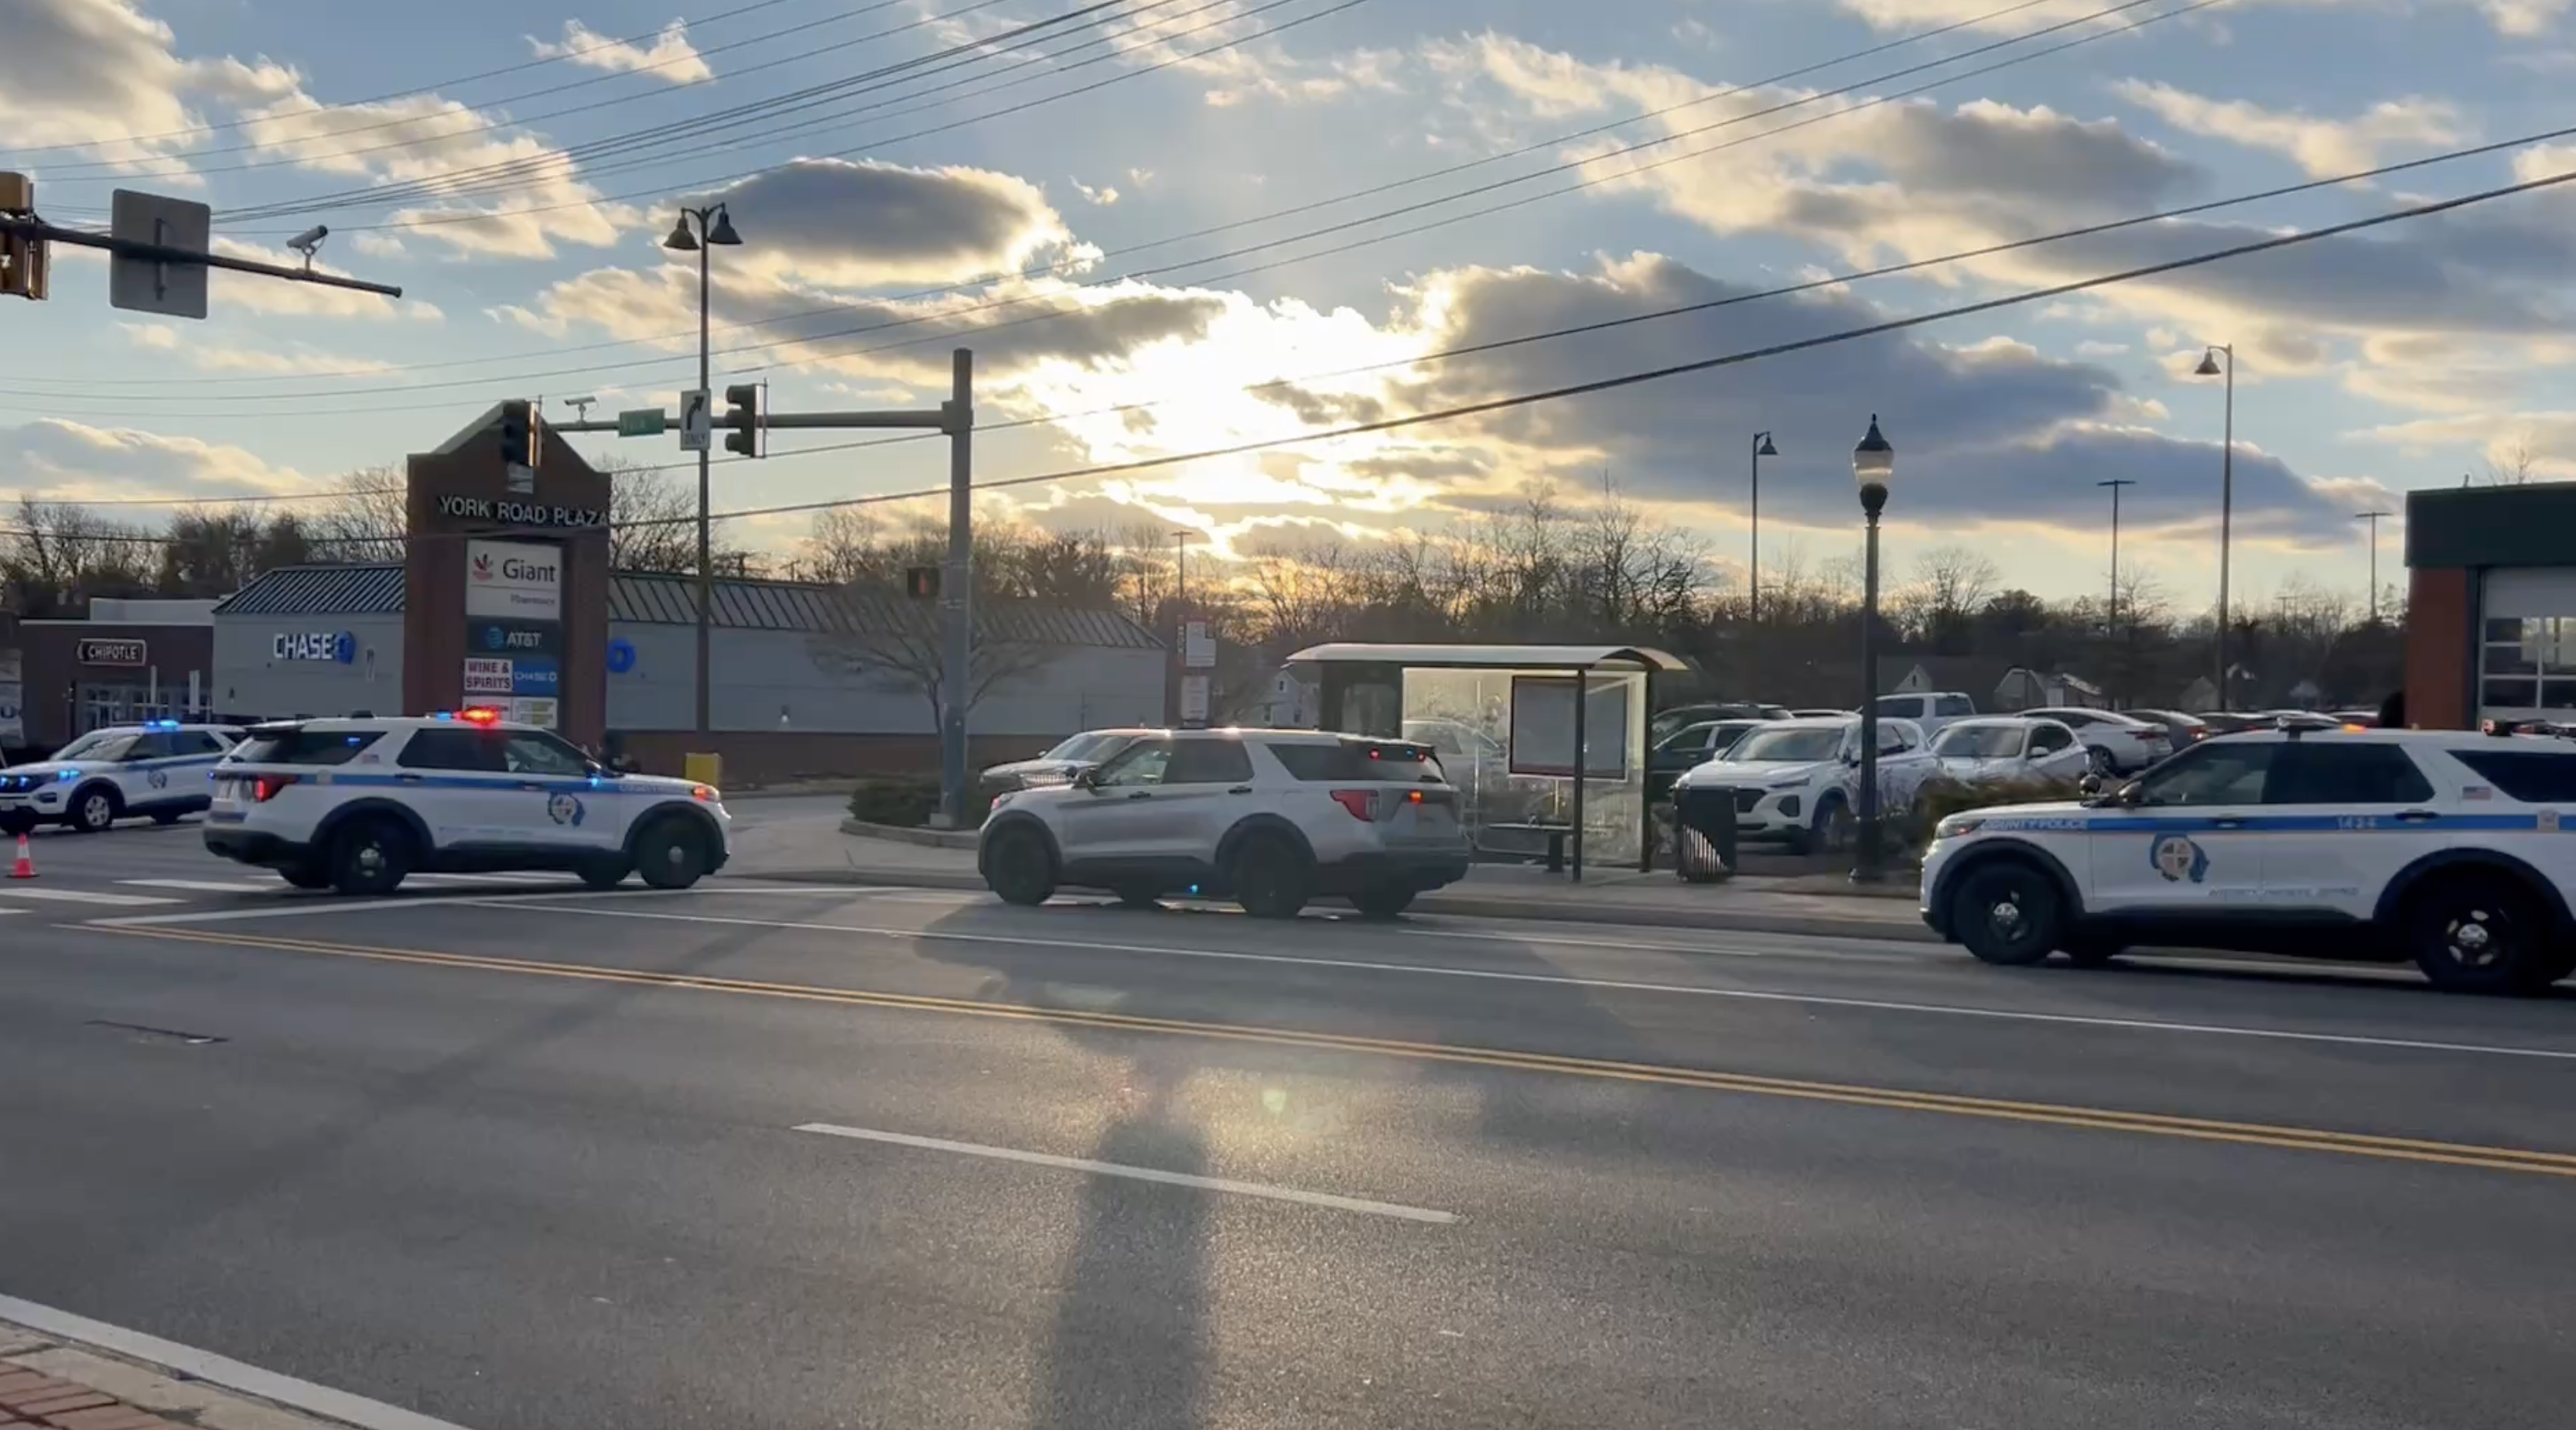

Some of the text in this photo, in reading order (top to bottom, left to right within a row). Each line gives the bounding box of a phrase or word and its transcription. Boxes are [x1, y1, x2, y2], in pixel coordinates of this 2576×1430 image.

[439, 495, 609, 527] YORK ROAD PLAZA
[503, 558, 557, 582] Giant
[273, 633, 333, 659] CHASE
[507, 631, 542, 648] AT&T
[87, 645, 138, 660] CHIPOTLE
[468, 661, 509, 673] WINE &
[466, 676, 511, 689] SPIRITS
